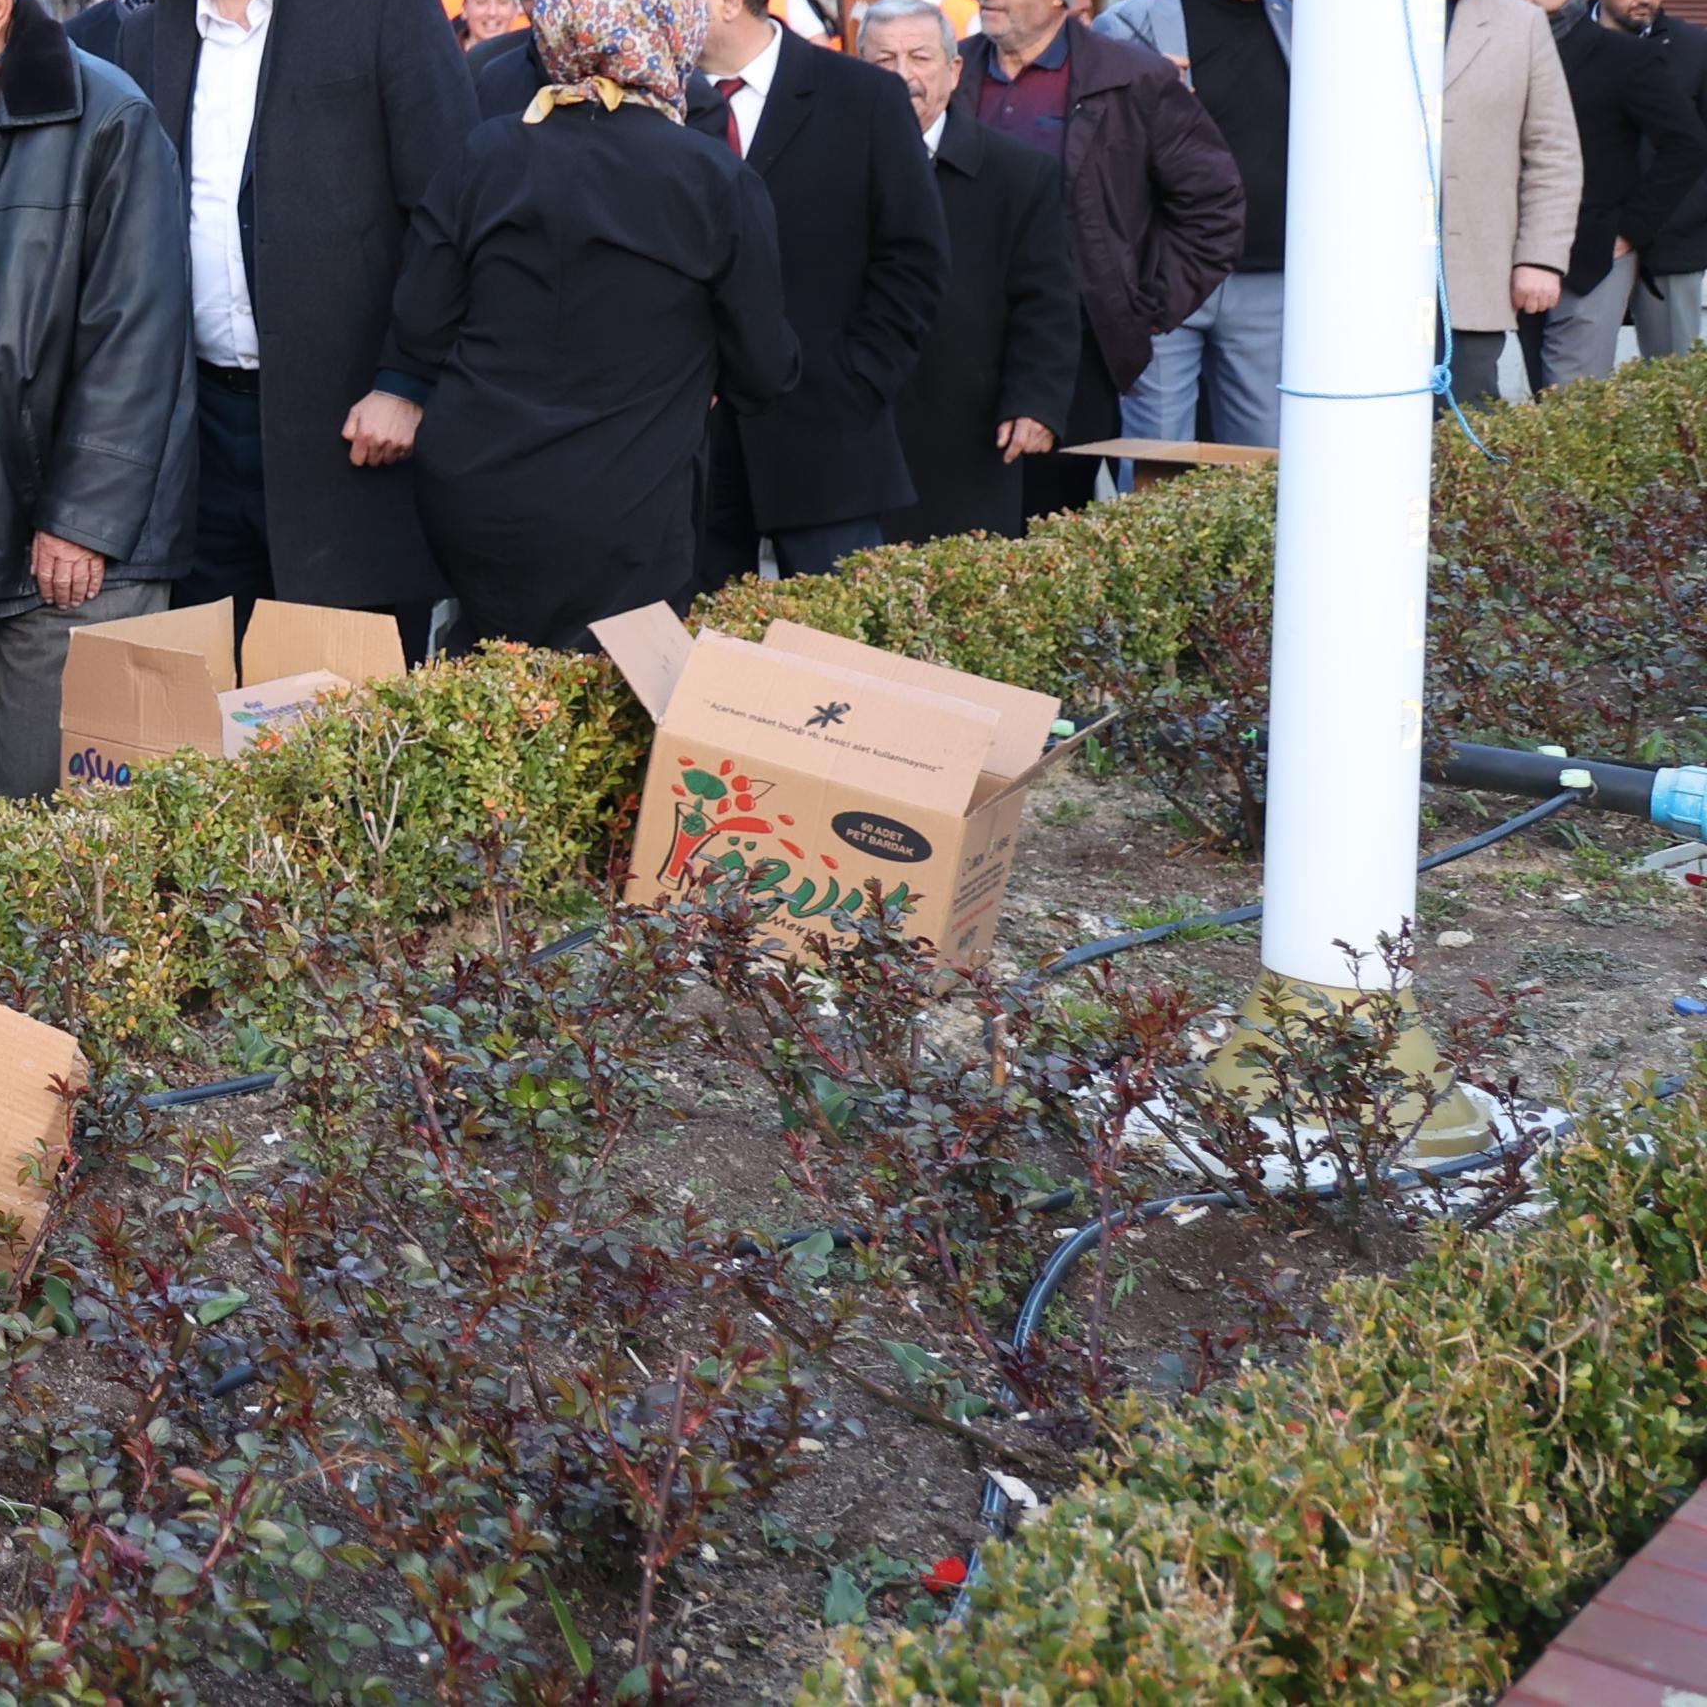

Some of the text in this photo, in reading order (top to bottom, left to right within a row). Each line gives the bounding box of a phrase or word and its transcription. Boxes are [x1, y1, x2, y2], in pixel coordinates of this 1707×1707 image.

[845, 828, 914, 856] PET BARDAK
[874, 826, 904, 842] ADET
